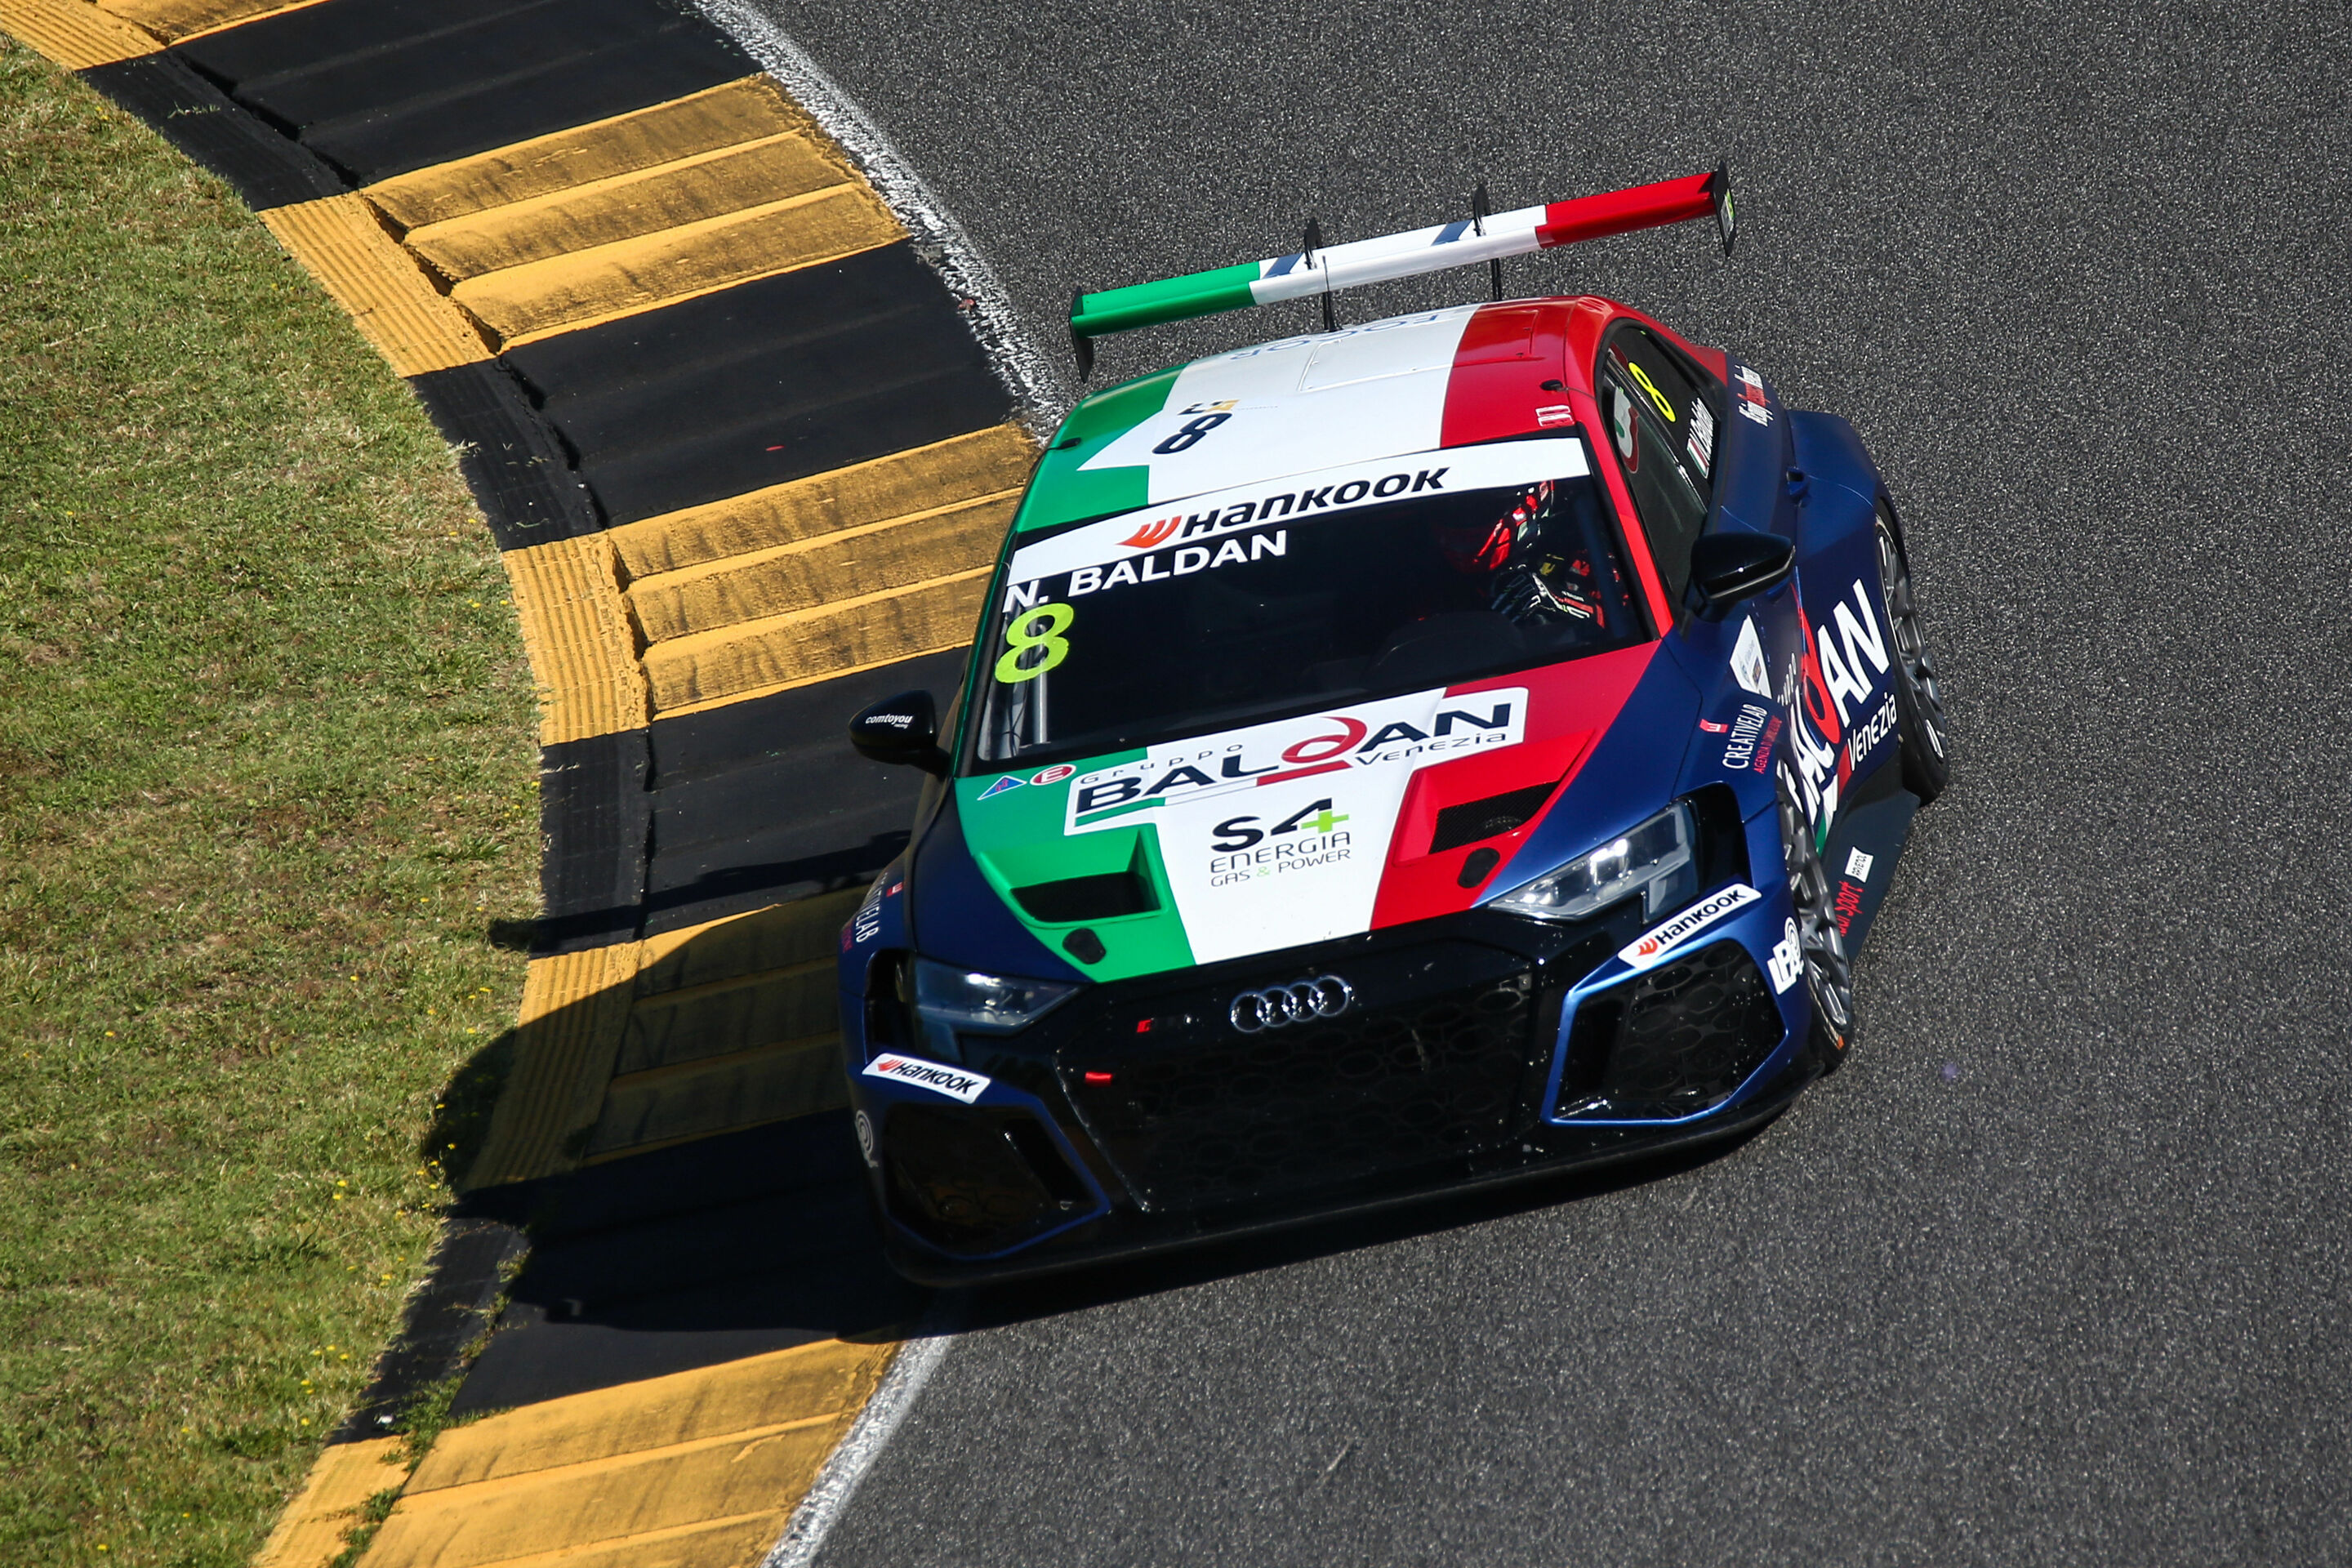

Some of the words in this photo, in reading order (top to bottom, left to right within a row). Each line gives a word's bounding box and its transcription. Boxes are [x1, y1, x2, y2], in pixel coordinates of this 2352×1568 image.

[1628, 362, 1676, 422] 8
[1152, 412, 1232, 454] 8
[1002, 579, 1050, 613] N.
[1067, 529, 1288, 598] BALDAN
[994, 602, 1075, 684] 8
[866, 713, 913, 724] comtoyou
[1722, 704, 1768, 769] CREATIVELAB
[1041, 767, 1065, 782] E
[1080, 743, 1243, 785] Gruppo
[1210, 831, 1351, 874] ENERGIA
[1210, 870, 1251, 888] GAS
[1256, 866, 1271, 878] &
[1278, 849, 1352, 873] POWER
